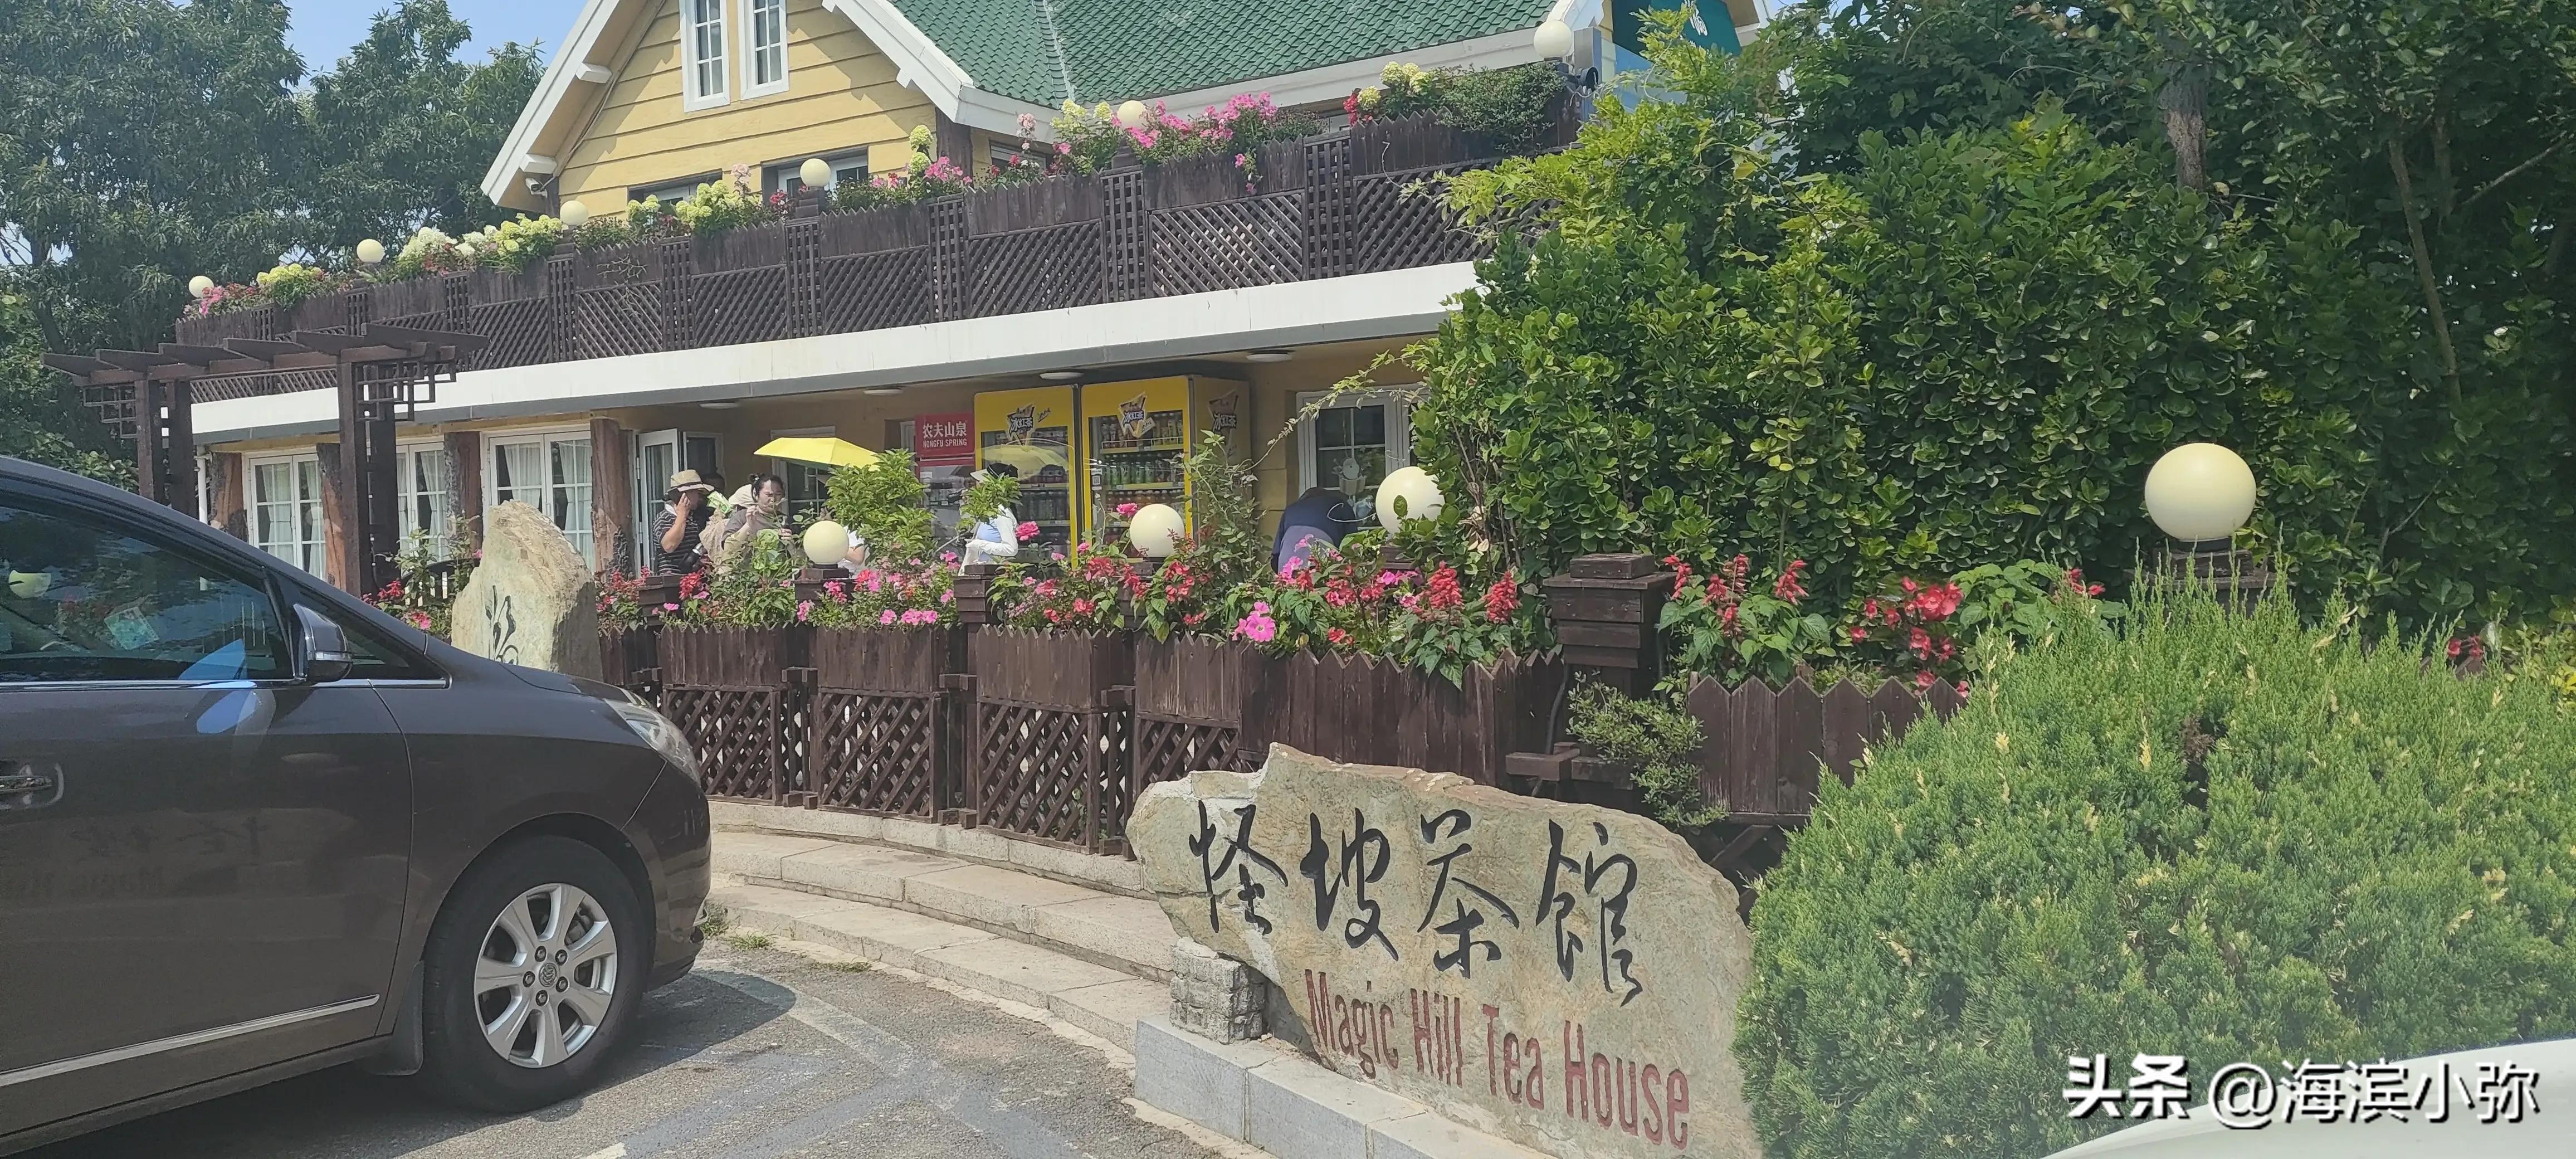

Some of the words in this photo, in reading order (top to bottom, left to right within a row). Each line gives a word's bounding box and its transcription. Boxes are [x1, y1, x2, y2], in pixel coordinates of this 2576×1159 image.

[923, 421, 967, 439] 农夫山泉
[923, 440, 943, 448] NONGFU
[945, 439, 967, 447] SPRING
[1189, 800, 1643, 1006] 怪坡茶馆
[1305, 970, 1399, 1078] Magic
[1411, 988, 1462, 1088] Hill
[1482, 1005, 1545, 1111] Tea
[1564, 1020, 1689, 1150] House
